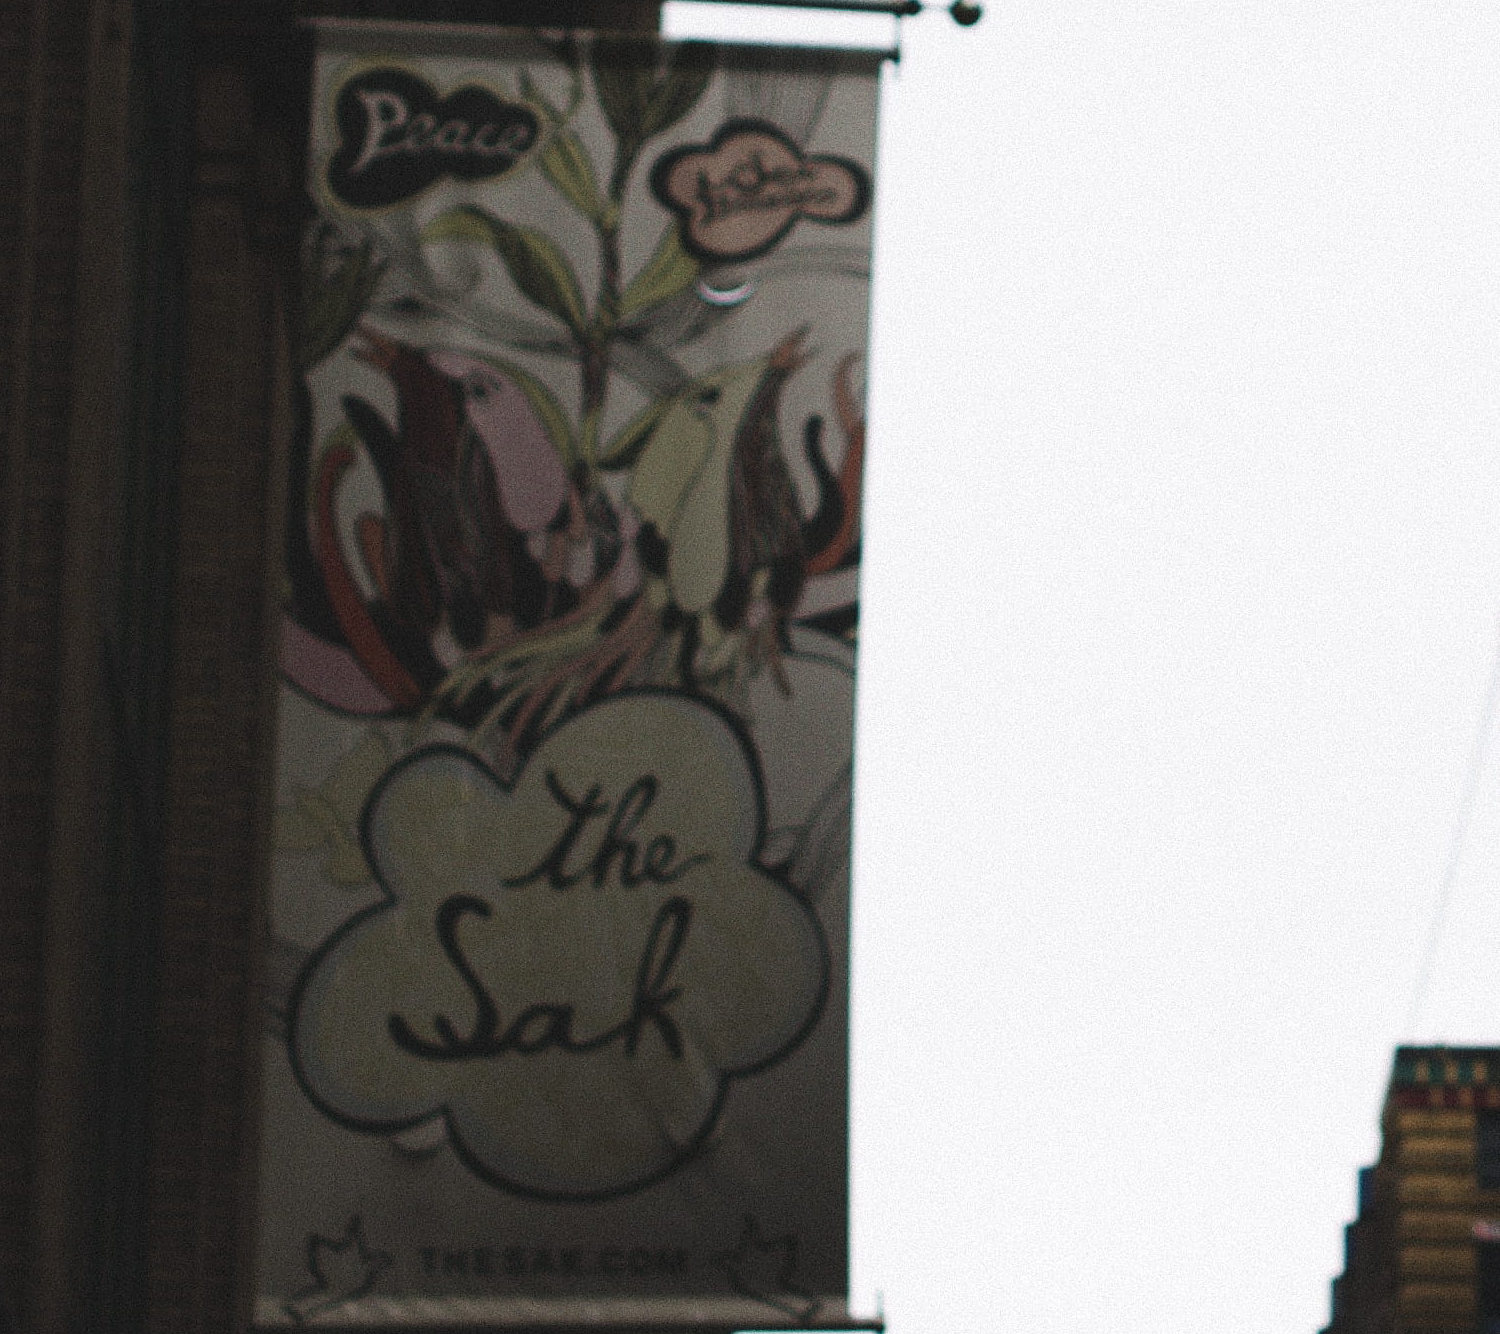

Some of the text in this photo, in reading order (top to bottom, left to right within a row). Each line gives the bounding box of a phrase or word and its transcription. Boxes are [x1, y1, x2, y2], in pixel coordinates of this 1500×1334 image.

[349, 89, 528, 174] Peace
[502, 770, 710, 890] the
[389, 894, 691, 1060] Sak
